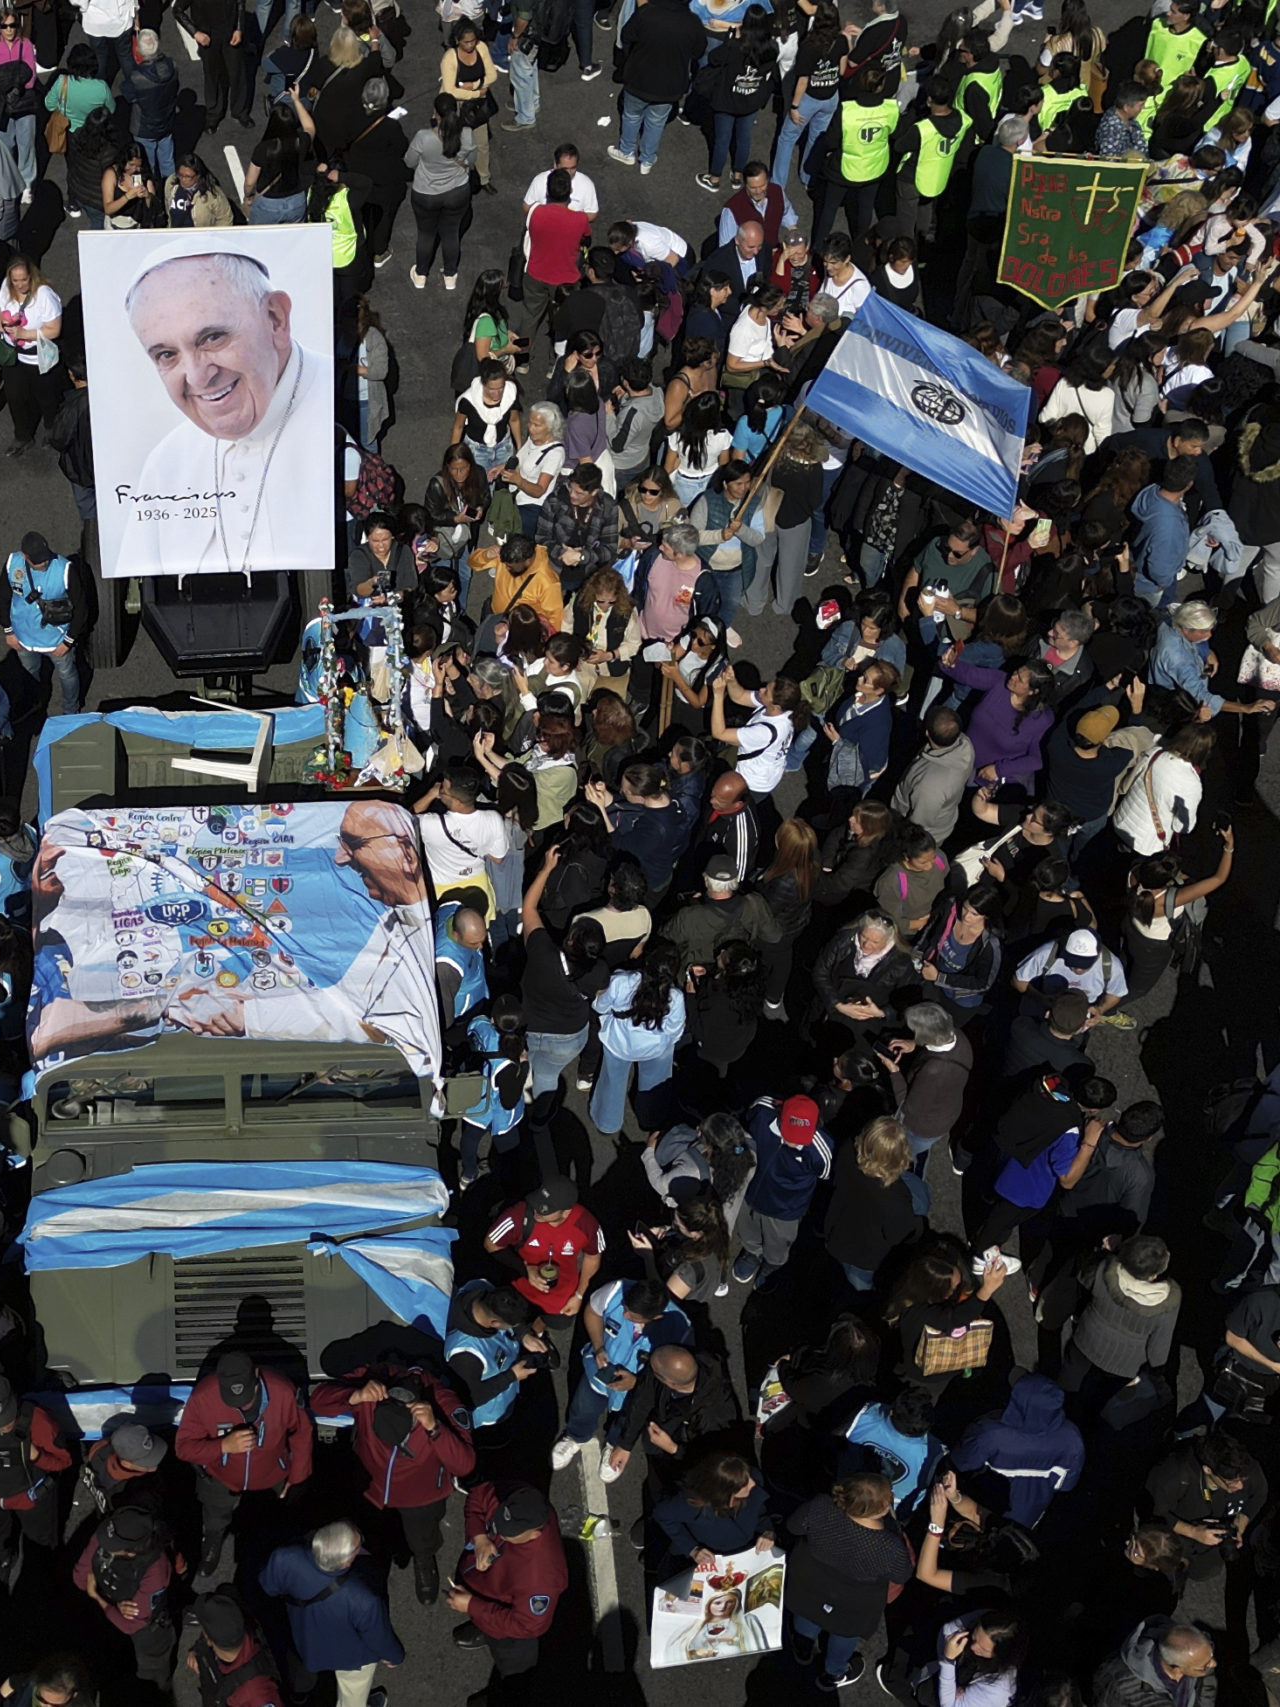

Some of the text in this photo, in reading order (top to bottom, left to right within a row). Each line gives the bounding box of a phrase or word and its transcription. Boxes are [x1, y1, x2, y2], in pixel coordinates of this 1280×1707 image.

[1018, 222, 1049, 246] Sra
[1038, 249, 1057, 266] de
[1001, 256, 1117, 297] DOLORES
[136, 508, 170, 521] 1936
[183, 506, 218, 519] 2025
[114, 916, 145, 928] LIGAS
